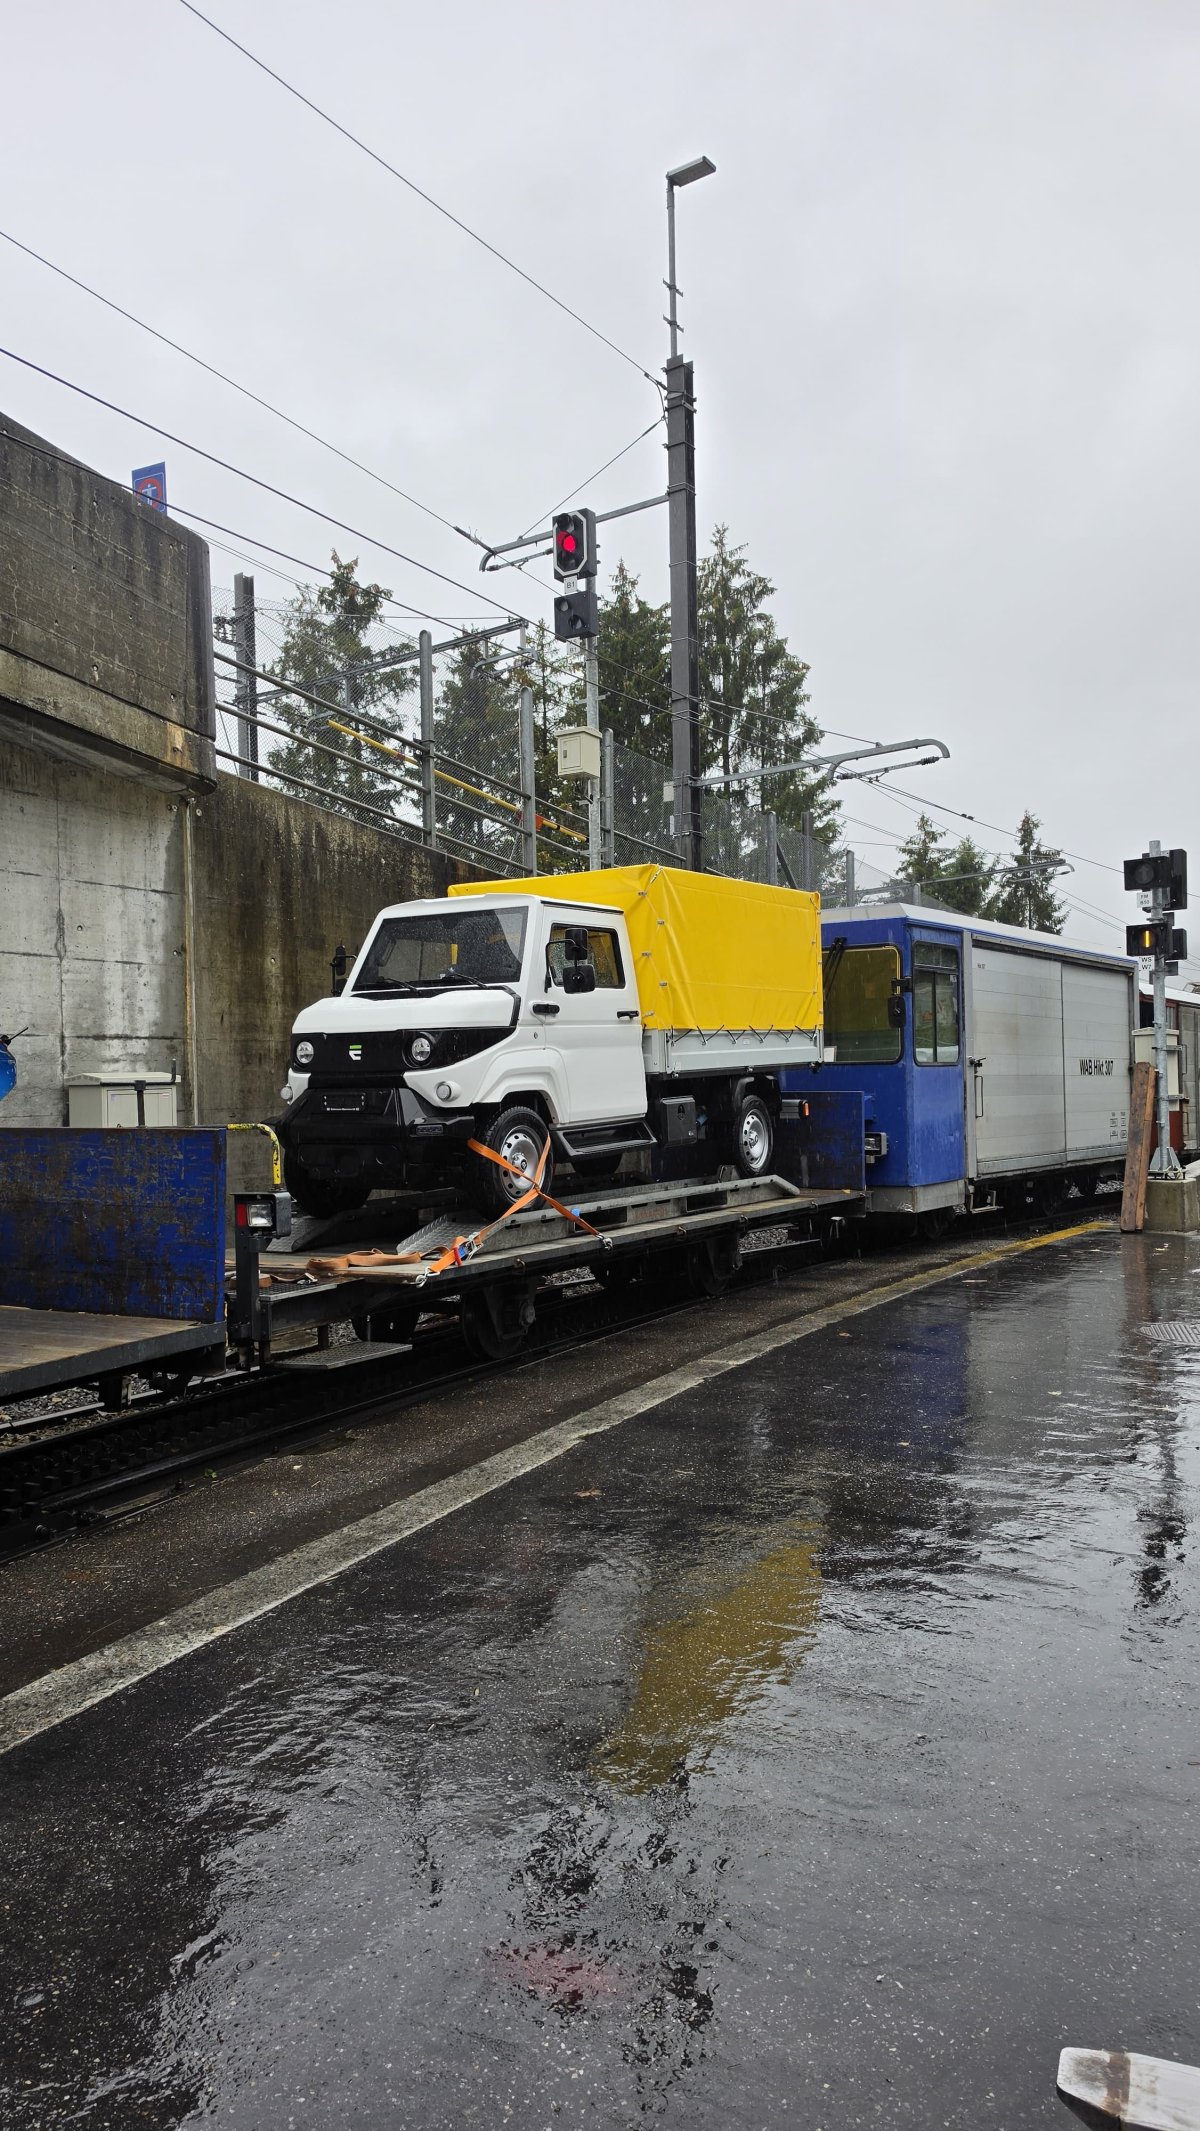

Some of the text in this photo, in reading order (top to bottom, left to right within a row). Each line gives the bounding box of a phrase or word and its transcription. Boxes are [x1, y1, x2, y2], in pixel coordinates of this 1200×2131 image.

[567, 581, 575, 589] B1
[1080, 1059, 1092, 1075] WAB
[1105, 1060, 1113, 1076] 307
